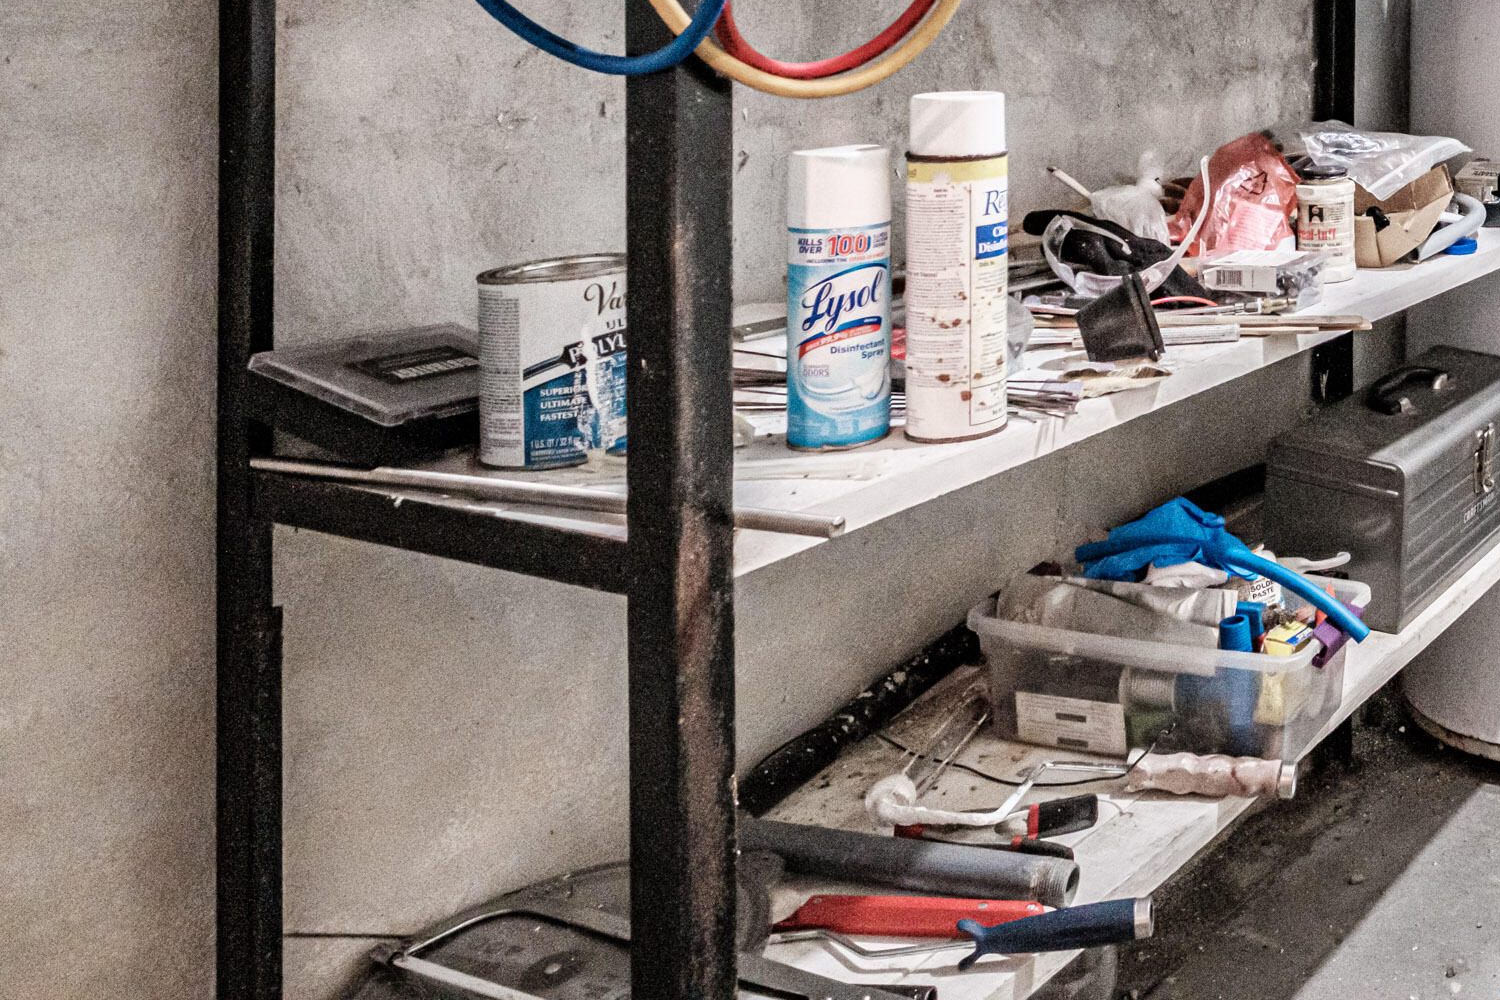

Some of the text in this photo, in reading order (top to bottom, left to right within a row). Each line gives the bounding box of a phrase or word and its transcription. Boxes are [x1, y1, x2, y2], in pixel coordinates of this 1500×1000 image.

[797, 238, 823, 246] KILLS
[828, 234, 868, 256] 100
[798, 246, 822, 254] OVER
[802, 271, 882, 332] Lysol
[606, 318, 626, 330] UL
[830, 338, 885, 354] Disinfectant
[861, 348, 884, 360] Spray
[803, 368, 830, 377] ODORS
[1252, 587, 1274, 600] PASTE
